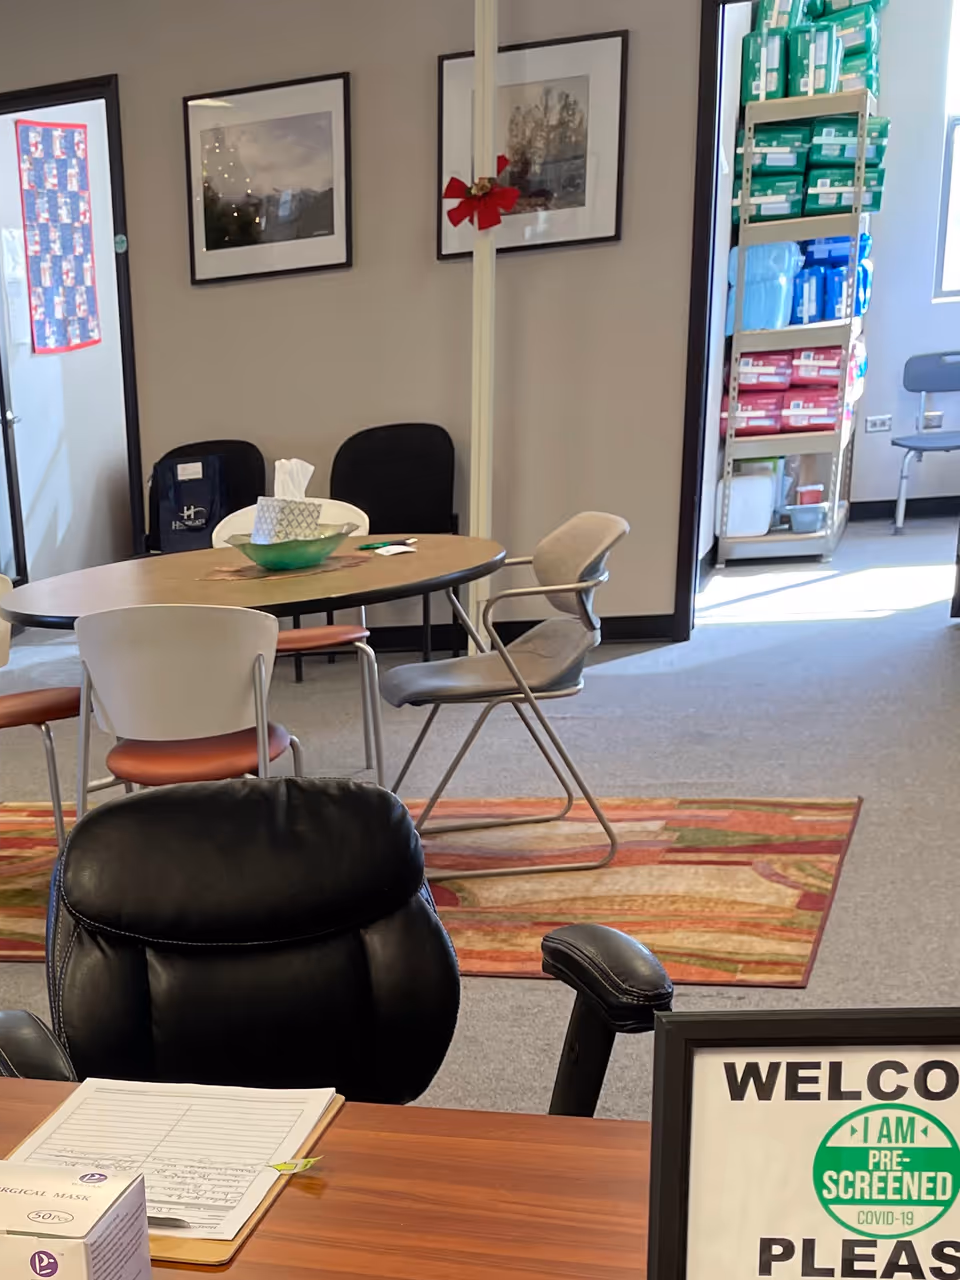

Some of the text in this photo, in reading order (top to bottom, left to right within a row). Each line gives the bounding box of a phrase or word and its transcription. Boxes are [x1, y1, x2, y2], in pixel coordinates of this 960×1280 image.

[723, 1060, 960, 1101] WELCO
[862, 1116, 916, 1144] I AM
[868, 1150, 911, 1170] PRE-
[53, 1192, 92, 1201] MASK
[822, 1170, 953, 1201] SCREENED
[857, 1210, 914, 1226] COVID-19
[758, 1237, 960, 1280] PLEAS
